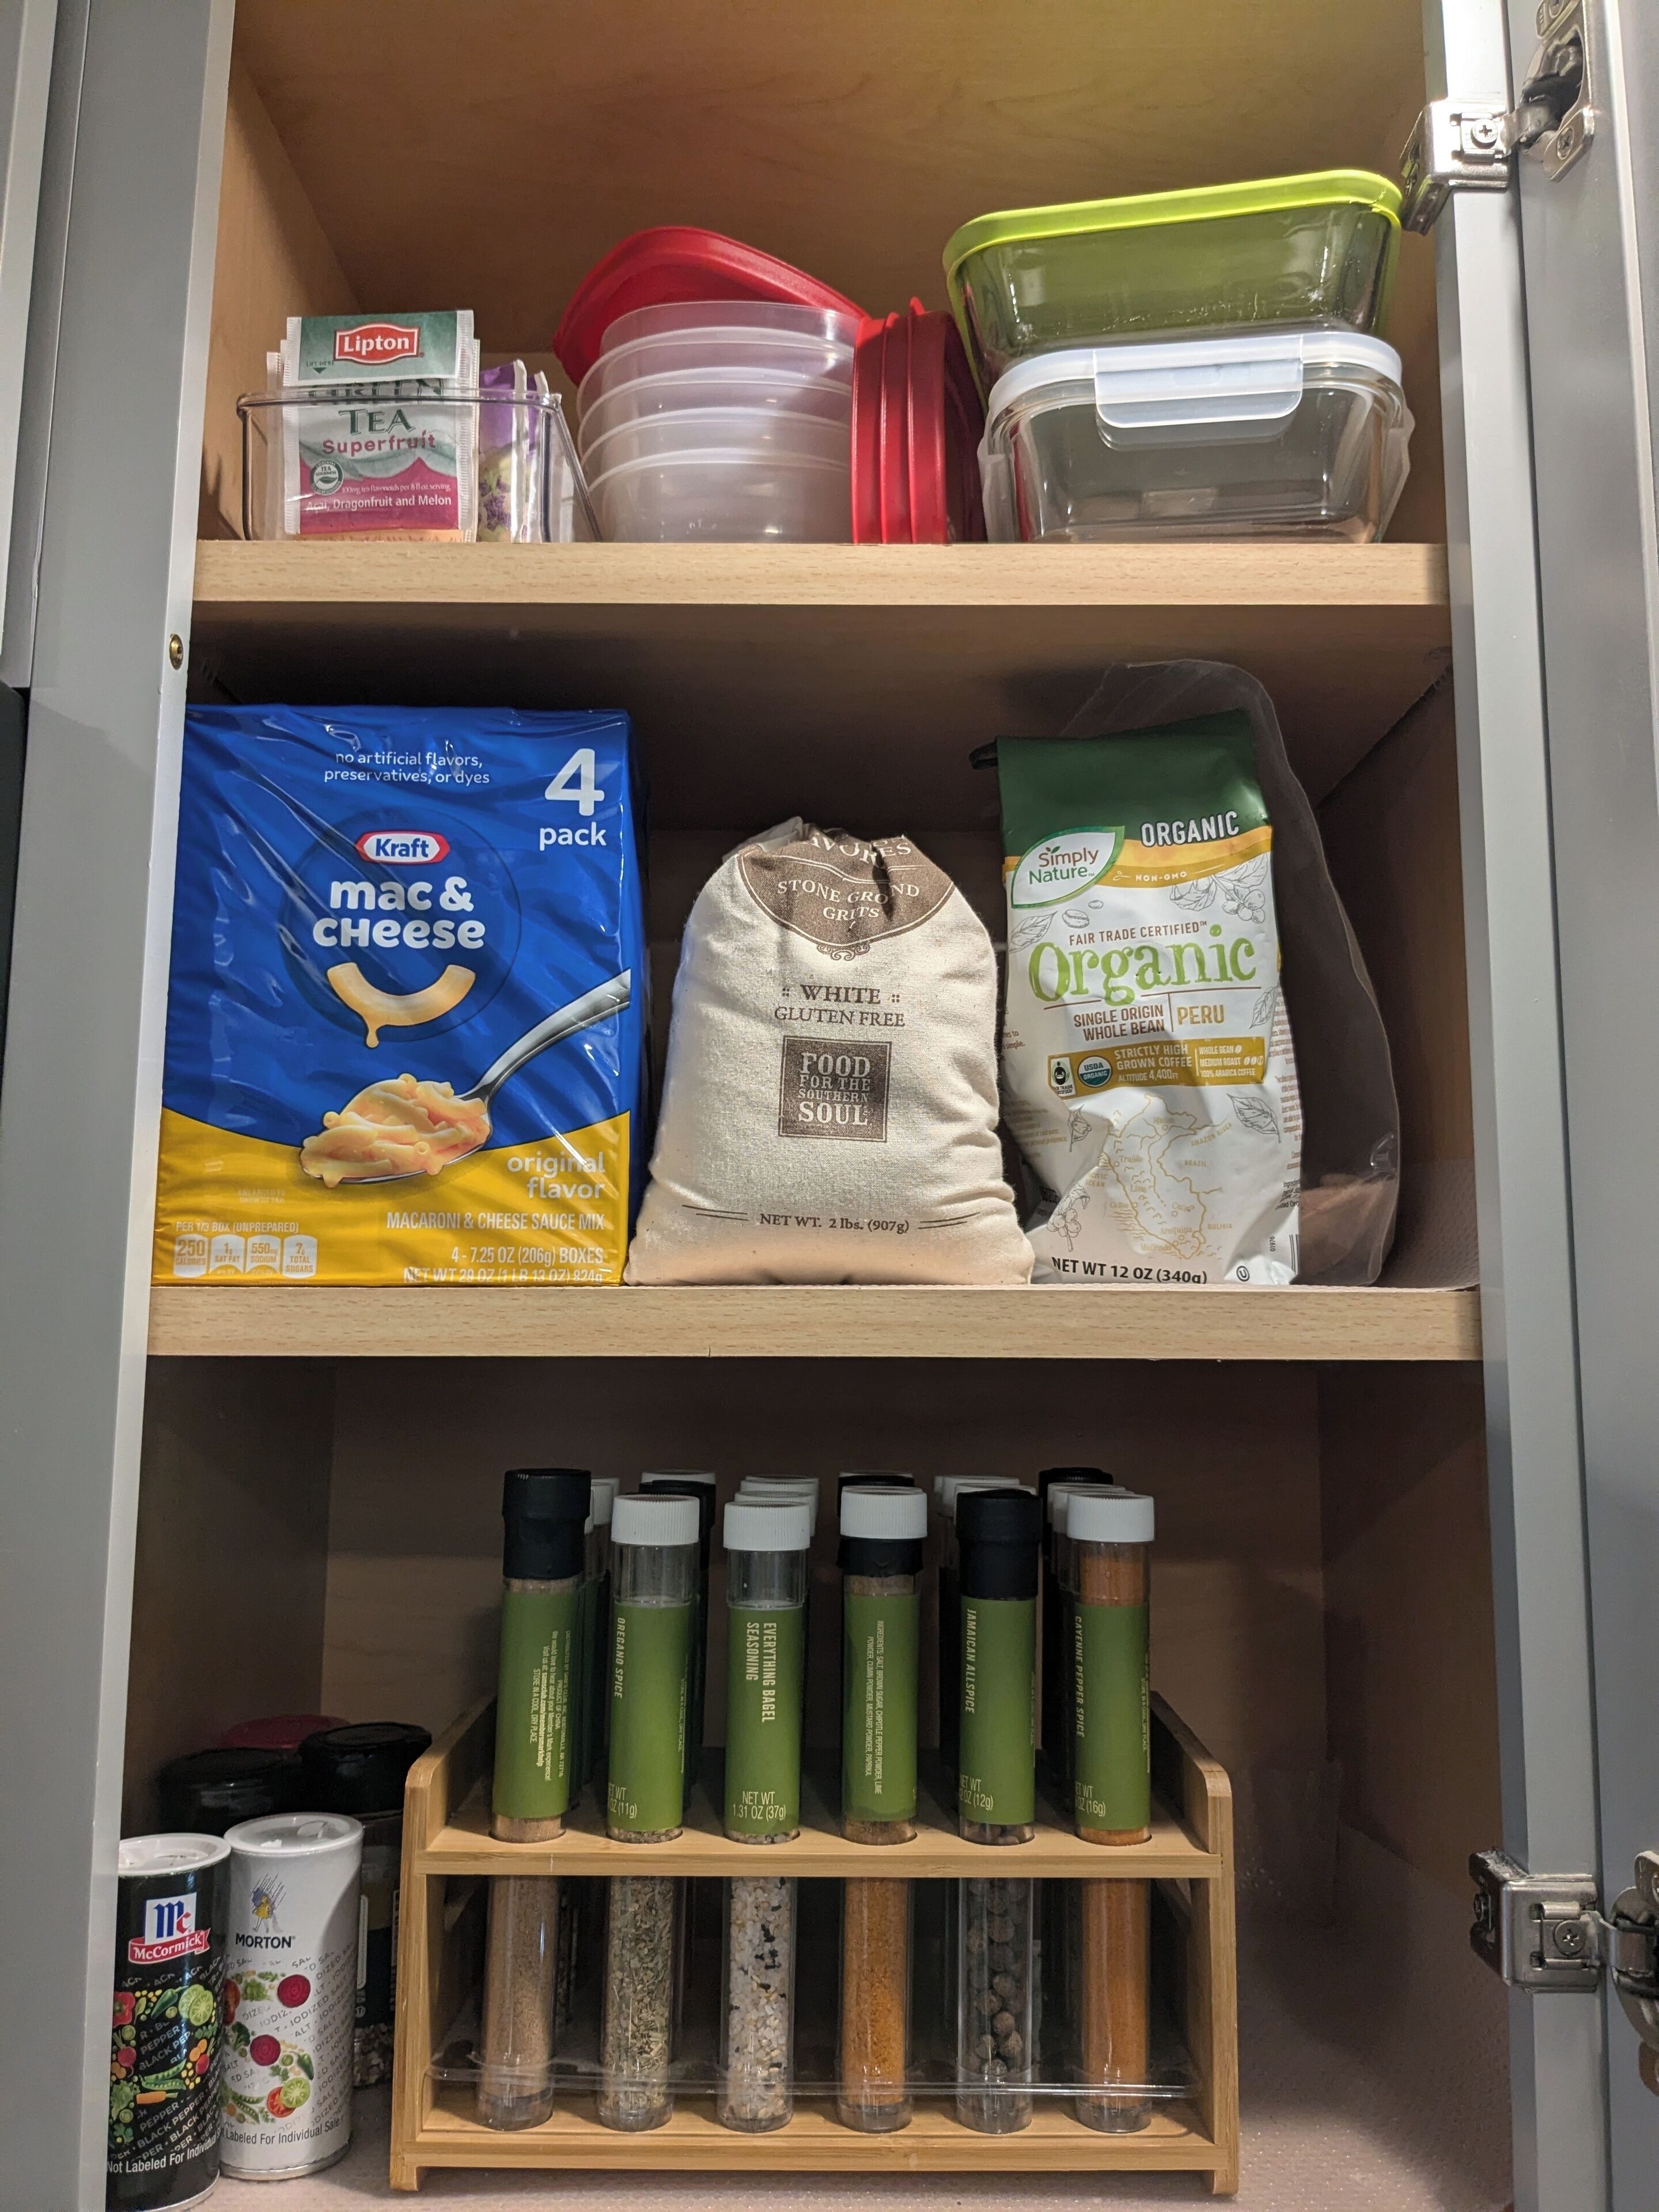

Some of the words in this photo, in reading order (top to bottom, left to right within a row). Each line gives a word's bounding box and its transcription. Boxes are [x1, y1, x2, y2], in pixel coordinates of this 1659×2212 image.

[344, 335, 409, 355] Lipton
[339, 408, 415, 436] TEA
[323, 431, 435, 456] Superfruit
[334, 496, 392, 509] Dragonfruit
[394, 497, 415, 506] and
[418, 495, 452, 505] Melon
[335, 752, 354, 764] no
[358, 752, 421, 765] artificial
[425, 752, 483, 767] flavors,
[324, 768, 431, 785] preservatives,
[435, 773, 452, 783] or
[455, 771, 490, 786] dyes
[544, 748, 605, 816] 4
[539, 821, 607, 851] pack
[1141, 811, 1240, 847] ORGANIC
[375, 838, 429, 858] Kraft
[1039, 846, 1099, 868] Simply
[1029, 866, 1088, 885] Nature
[1136, 870, 1187, 881] NON-GMO
[329, 880, 433, 911] mac
[439, 876, 474, 911] &
[778, 880, 840, 903] STONE
[847, 884, 920, 904] GROND
[823, 907, 880, 923] GRITS
[1069, 933, 1094, 946] FAIR
[1101, 929, 1136, 941] TRADE
[1029, 924, 1256, 1006] Organic
[800, 985, 881, 1005] WHITE
[775, 1006, 854, 1025] GLUTEN
[859, 1012, 905, 1027] FREE
[1074, 1009, 1117, 1027] SINGLE
[1120, 1005, 1163, 1021] ORIGIN
[1177, 1005, 1225, 1025] PERU
[1083, 1022, 1127, 1041] WHOLE
[1131, 1019, 1165, 1035] BEAN
[1115, 1046, 1160, 1060] STRICTLY
[1163, 1044, 1188, 1054] HIGH
[1199, 1046, 1218, 1055] WHOLE
[1219, 1046, 1234, 1054] BEAN
[800, 1052, 871, 1077] FOOD
[1084, 1062, 1104, 1071] USDA
[1116, 1057, 1155, 1070] GROWN
[1159, 1056, 1192, 1067] COFFEE
[1200, 1058, 1223, 1067] MEDIUM
[1224, 1058, 1240, 1066] ROAST
[1200, 1070, 1214, 1078] 100%
[1215, 1069, 1237, 1077] ARABICA
[1238, 1068, 1256, 1076] COFFEE
[800, 1076, 833, 1089] FOR
[839, 1078, 870, 1092] THE
[1083, 1070, 1107, 1080] ORGANIC
[1118, 1073, 1147, 1082] ALTITUDE
[798, 1089, 869, 1103] SOUTHERN
[798, 1102, 868, 1126] SOUL
[507, 1152, 605, 1178] original
[527, 1177, 605, 1199] flavor
[176, 1222, 193, 1232] PER
[212, 1222, 230, 1232] BOX
[233, 1222, 298, 1233] (UNPREPARED)
[387, 1211, 460, 1229] MACARONI
[464, 1213, 474, 1229] &
[477, 1213, 527, 1229] CHEESE
[531, 1213, 574, 1230] SAUCE
[578, 1214, 604, 1230] MIX
[760, 1214, 791, 1228] NET
[795, 1215, 822, 1228] WT.
[829, 1218, 836, 1229] 2
[839, 1217, 863, 1230] lbs.
[868, 1219, 910, 1234] (907g)
[177, 1240, 206, 1256] 250
[452, 1247, 459, 1263] 4
[471, 1247, 494, 1263] 7.25
[498, 1247, 514, 1263] OZ
[518, 1246, 555, 1267] (206g)
[559, 1247, 603, 1263] BOXES
[433, 1268, 456, 1282] WT
[478, 1268, 494, 1282] OZ
[512, 1268, 527, 1282] LB
[1051, 1256, 1079, 1273] NET
[1082, 1260, 1106, 1277] WT
[1110, 1264, 1129, 1279] 12
[1132, 1266, 1153, 1281] OZ
[1156, 1269, 1207, 1285] (340g)
[617, 1617, 626, 1664] OREGANO
[967, 1608, 976, 1661] JAMAICAN
[1074, 1616, 1083, 1662] CAYENNE
[745, 1622, 759, 1681] SEASONING
[763, 1622, 777, 1687] EVERYTHING
[615, 1667, 623, 1698] SPICE
[965, 1664, 975, 1714] ALLSPICE
[1075, 1665, 1084, 1704] PEPPER
[762, 1689, 776, 1722] BAGEL
[536, 1672, 547, 1767] samsclub.com/membersmarkhelp
[547, 1713, 555, 1737] Member's
[1075, 1707, 1085, 1738] SPICE
[616, 1786, 627, 1800] WT
[970, 1777, 981, 1792] WT
[1082, 1784, 1093, 1799] WT
[743, 1791, 759, 1805] NET
[760, 1791, 775, 1804] WT
[973, 1790, 994, 1810] (12g)
[1086, 1798, 1106, 1817] (16g)
[618, 1800, 637, 1819] (11g)
[732, 1804, 748, 1817] 1.31
[751, 1805, 763, 1819] OZ
[766, 1804, 786, 1820] (37g)
[133, 1933, 203, 1960] McCormick
[236, 1933, 292, 1949] MORTON
[290, 1994, 329, 2027] IODIZED
[139, 2025, 180, 2055] PEPPER
[137, 2124, 172, 2147] BLACK
[172, 2093, 204, 2126] PEPPER
[139, 2103, 180, 2131] PEPPER
[171, 2115, 199, 2142] BLACK
[226, 2131, 257, 2144] Labeled
[260, 2134, 275, 2144] For
[278, 2127, 322, 2143] Individual
[325, 2116, 339, 2132] Sale
[126, 2157, 166, 2173] Labeled
[169, 2152, 183, 2166] For
[187, 2135, 217, 2160] Individual
